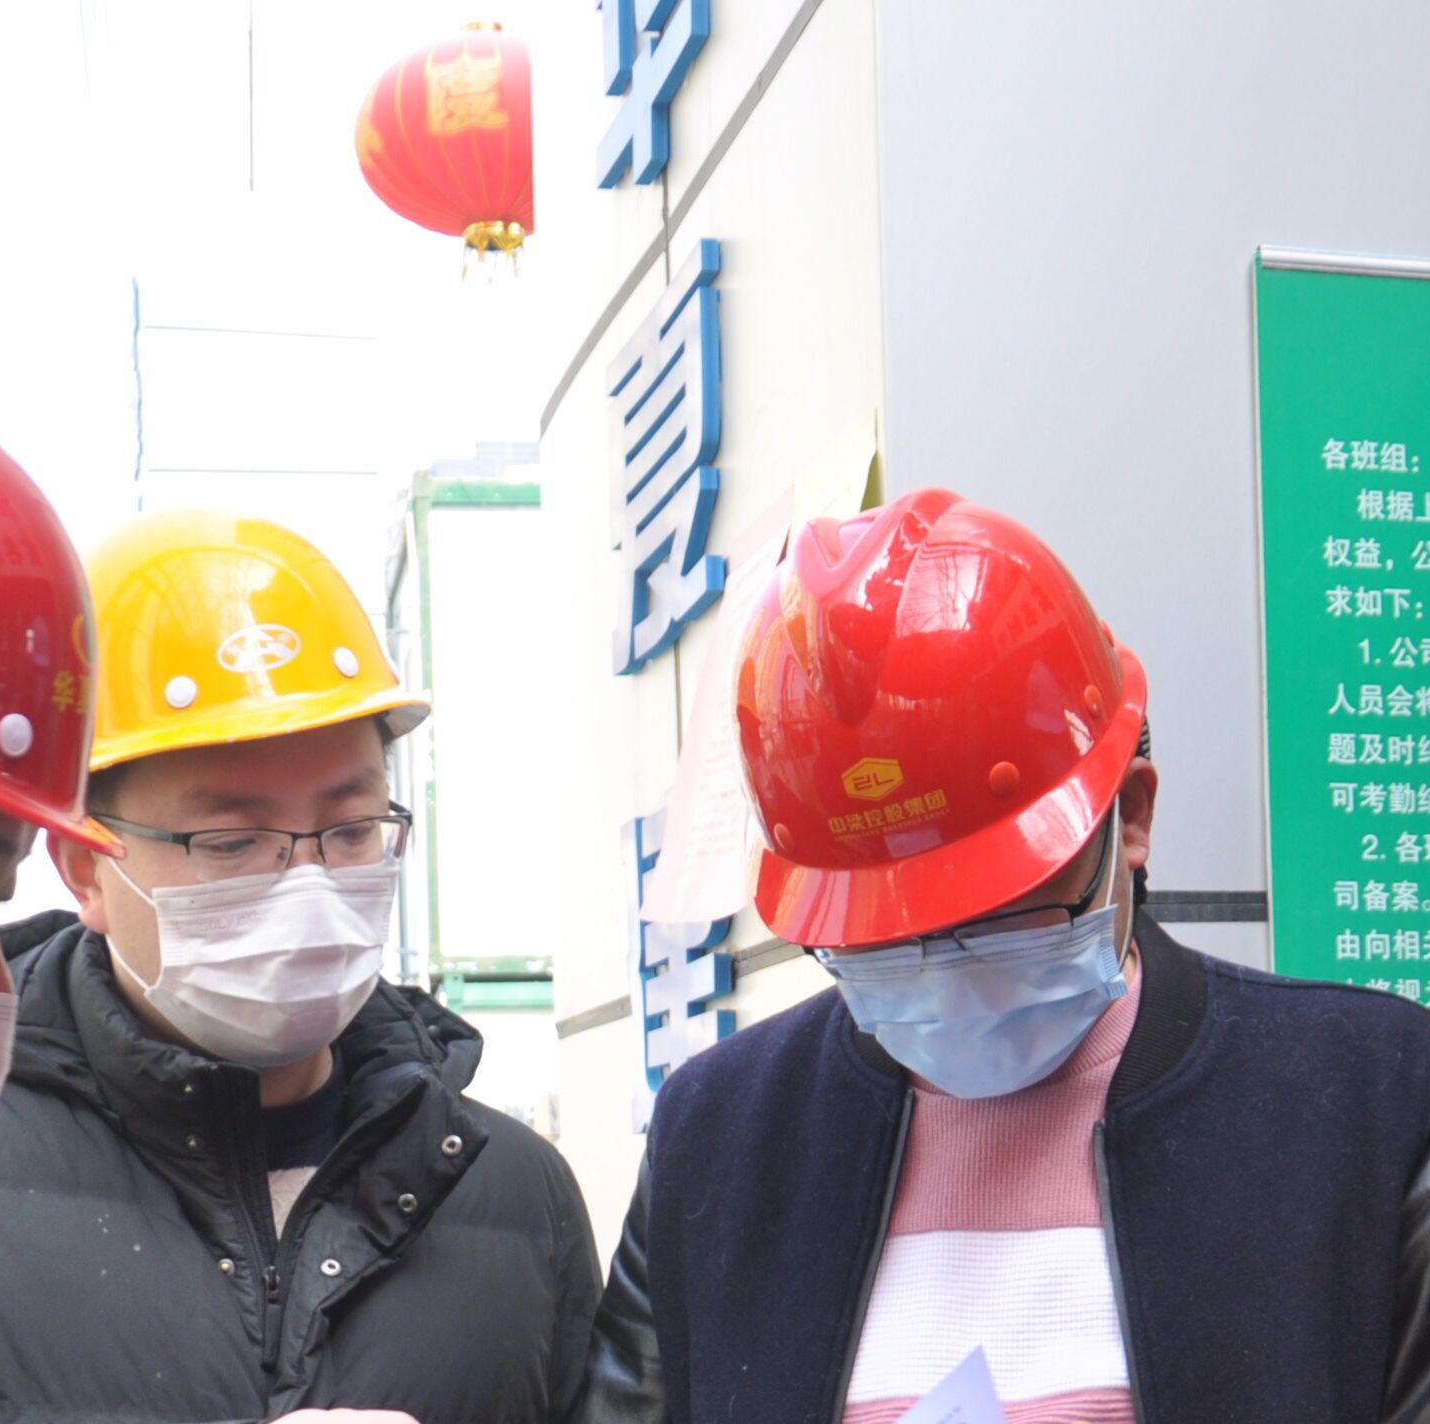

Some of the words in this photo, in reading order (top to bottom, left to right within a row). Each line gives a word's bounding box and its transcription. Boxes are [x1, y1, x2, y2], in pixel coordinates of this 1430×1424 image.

[1321, 438, 1420, 473] 各班组：
[1325, 585, 1423, 619] 求如下：
